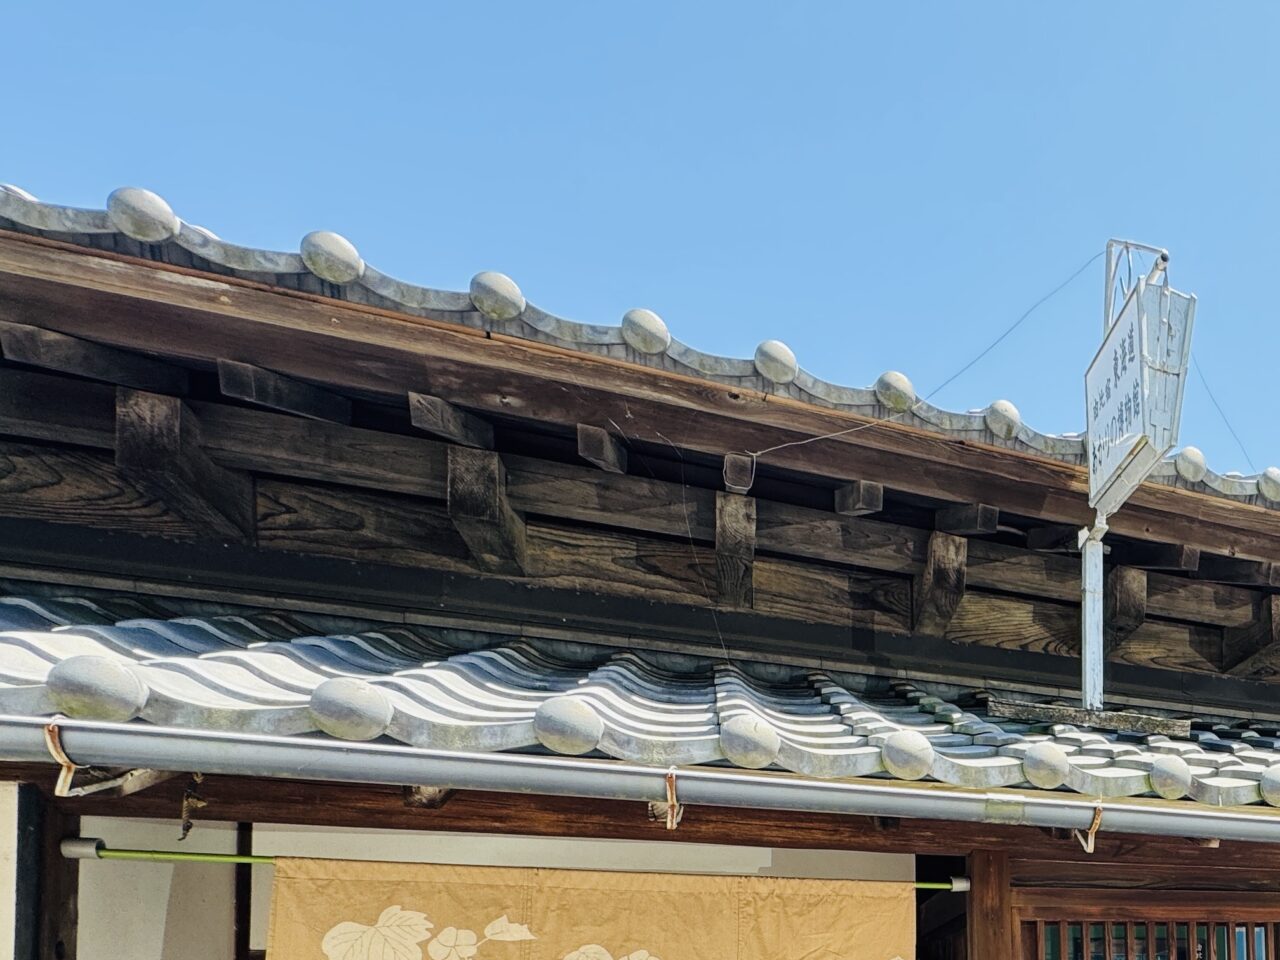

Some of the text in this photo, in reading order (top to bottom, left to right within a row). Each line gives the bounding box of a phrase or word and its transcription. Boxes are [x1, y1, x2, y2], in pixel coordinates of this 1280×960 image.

[1092, 378, 1140, 475] あかりの博物館
